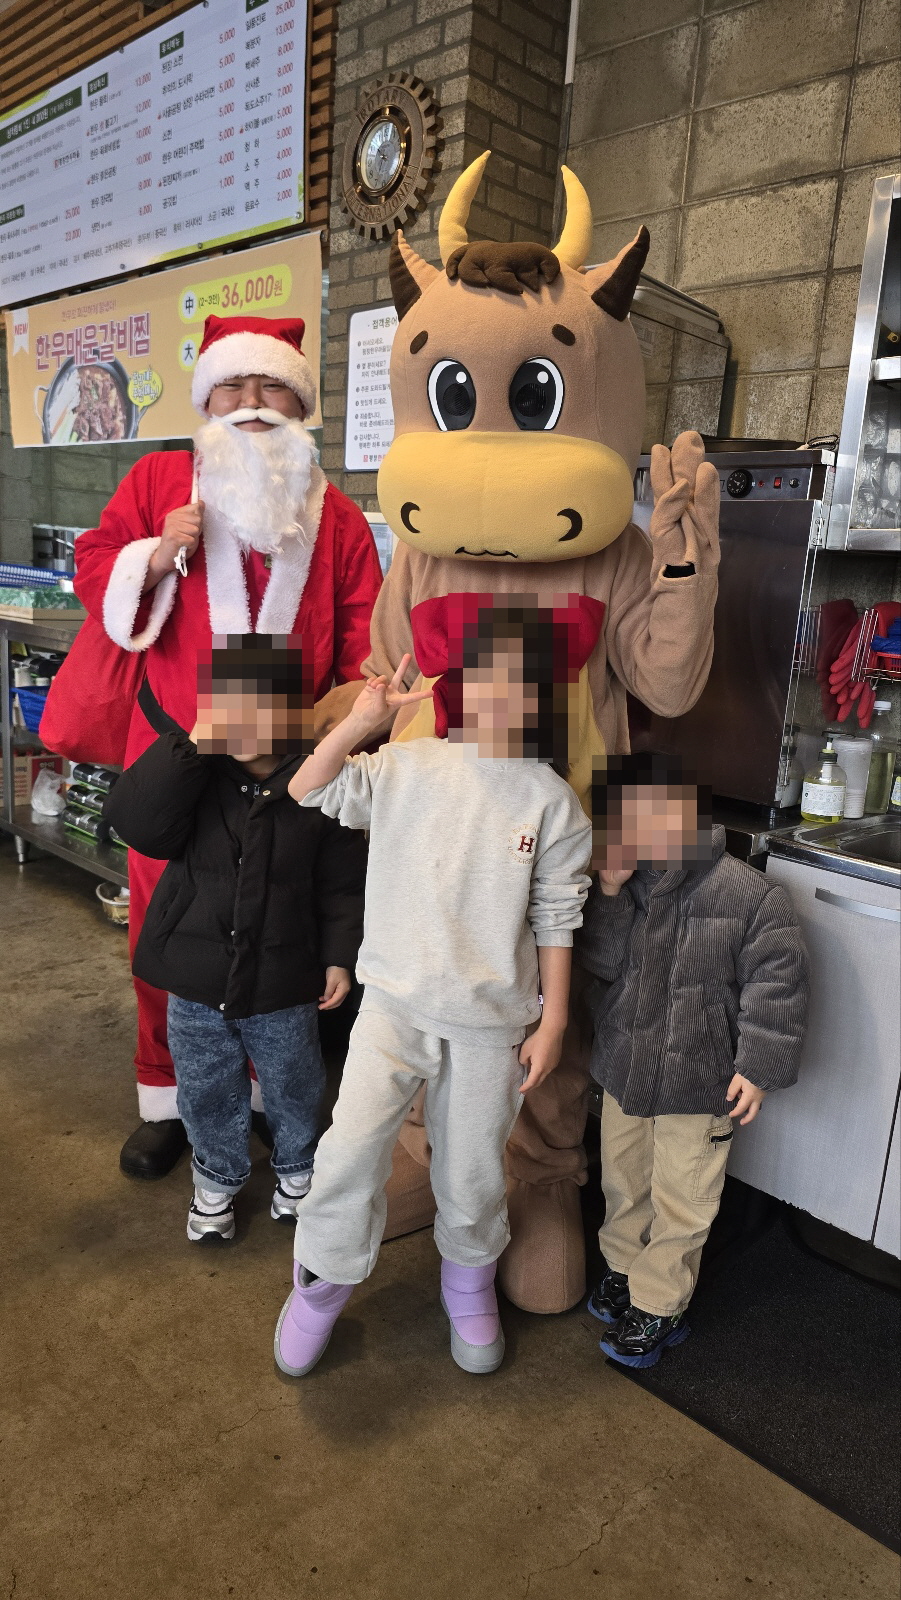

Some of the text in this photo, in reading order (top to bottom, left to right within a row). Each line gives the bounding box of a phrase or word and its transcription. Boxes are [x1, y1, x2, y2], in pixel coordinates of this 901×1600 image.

[276, 0, 295, 15] 25,000
[219, 27, 235, 44] 5,000
[276, 20, 295, 36] 13,000
[277, 41, 294, 56] 8,000
[219, 52, 235, 69] 5,000
[277, 62, 294, 77] 8,000
[178, 72, 193, 89] 도시락
[219, 77, 235, 93] 5,000
[277, 83, 293, 98] 7,000
[219, 102, 234, 118] 5,000
[277, 105, 293, 119] 5,000
[218, 126, 234, 141] 5,000
[276, 126, 292, 140] 5,000
[218, 150, 234, 166] 4,000
[276, 147, 292, 160] 4,000
[220, 175, 234, 189] 1,000
[276, 168, 292, 181] 4,000
[276, 188, 292, 202] 2,000
[245, 199, 260, 212] 음료수
[185, 296, 194, 314] 中
[221, 274, 283, 309] 36,000원
[14, 324, 28, 336] NEW
[372, 316, 398, 330] 접객용어
[36, 312, 150, 372] 한우매운갈비찜
[184, 343, 193, 361] 大
[362, 345, 392, 356] 평창한우마을입
[360, 383, 391, 393] 주문 도와드릴게
[517, 835, 535, 854] H
